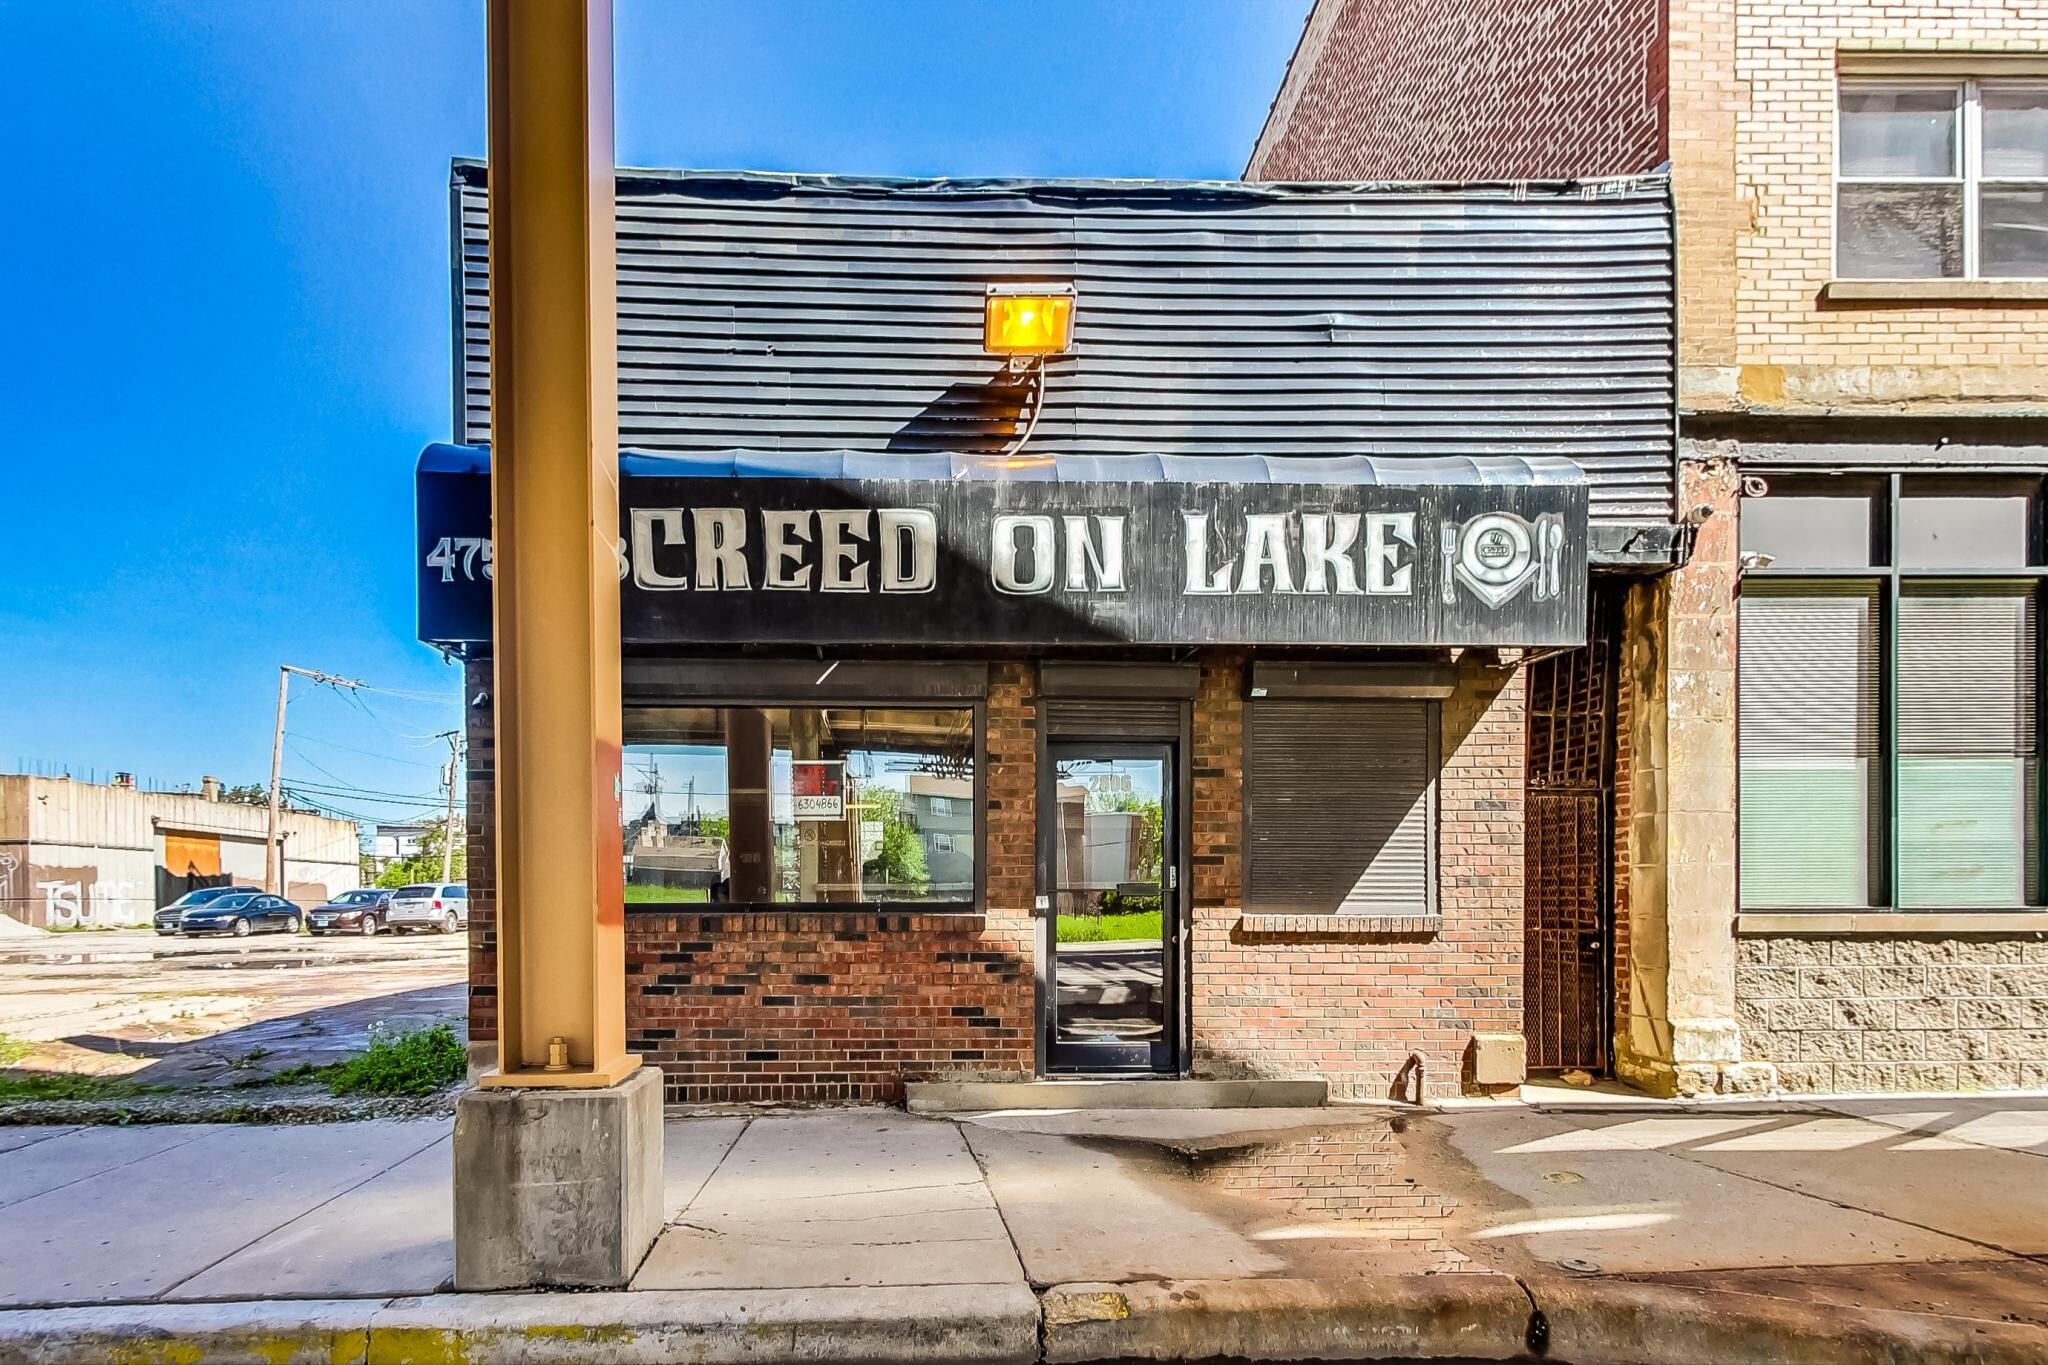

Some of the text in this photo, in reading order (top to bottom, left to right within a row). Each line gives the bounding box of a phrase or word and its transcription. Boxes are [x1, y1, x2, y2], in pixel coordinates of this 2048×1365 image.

[630, 507, 937, 593] CREED
[991, 514, 1126, 594] ON
[1181, 509, 1417, 596] LAKE
[1089, 774, 1132, 793] 2806
[792, 797, 838, 810] -6304866
